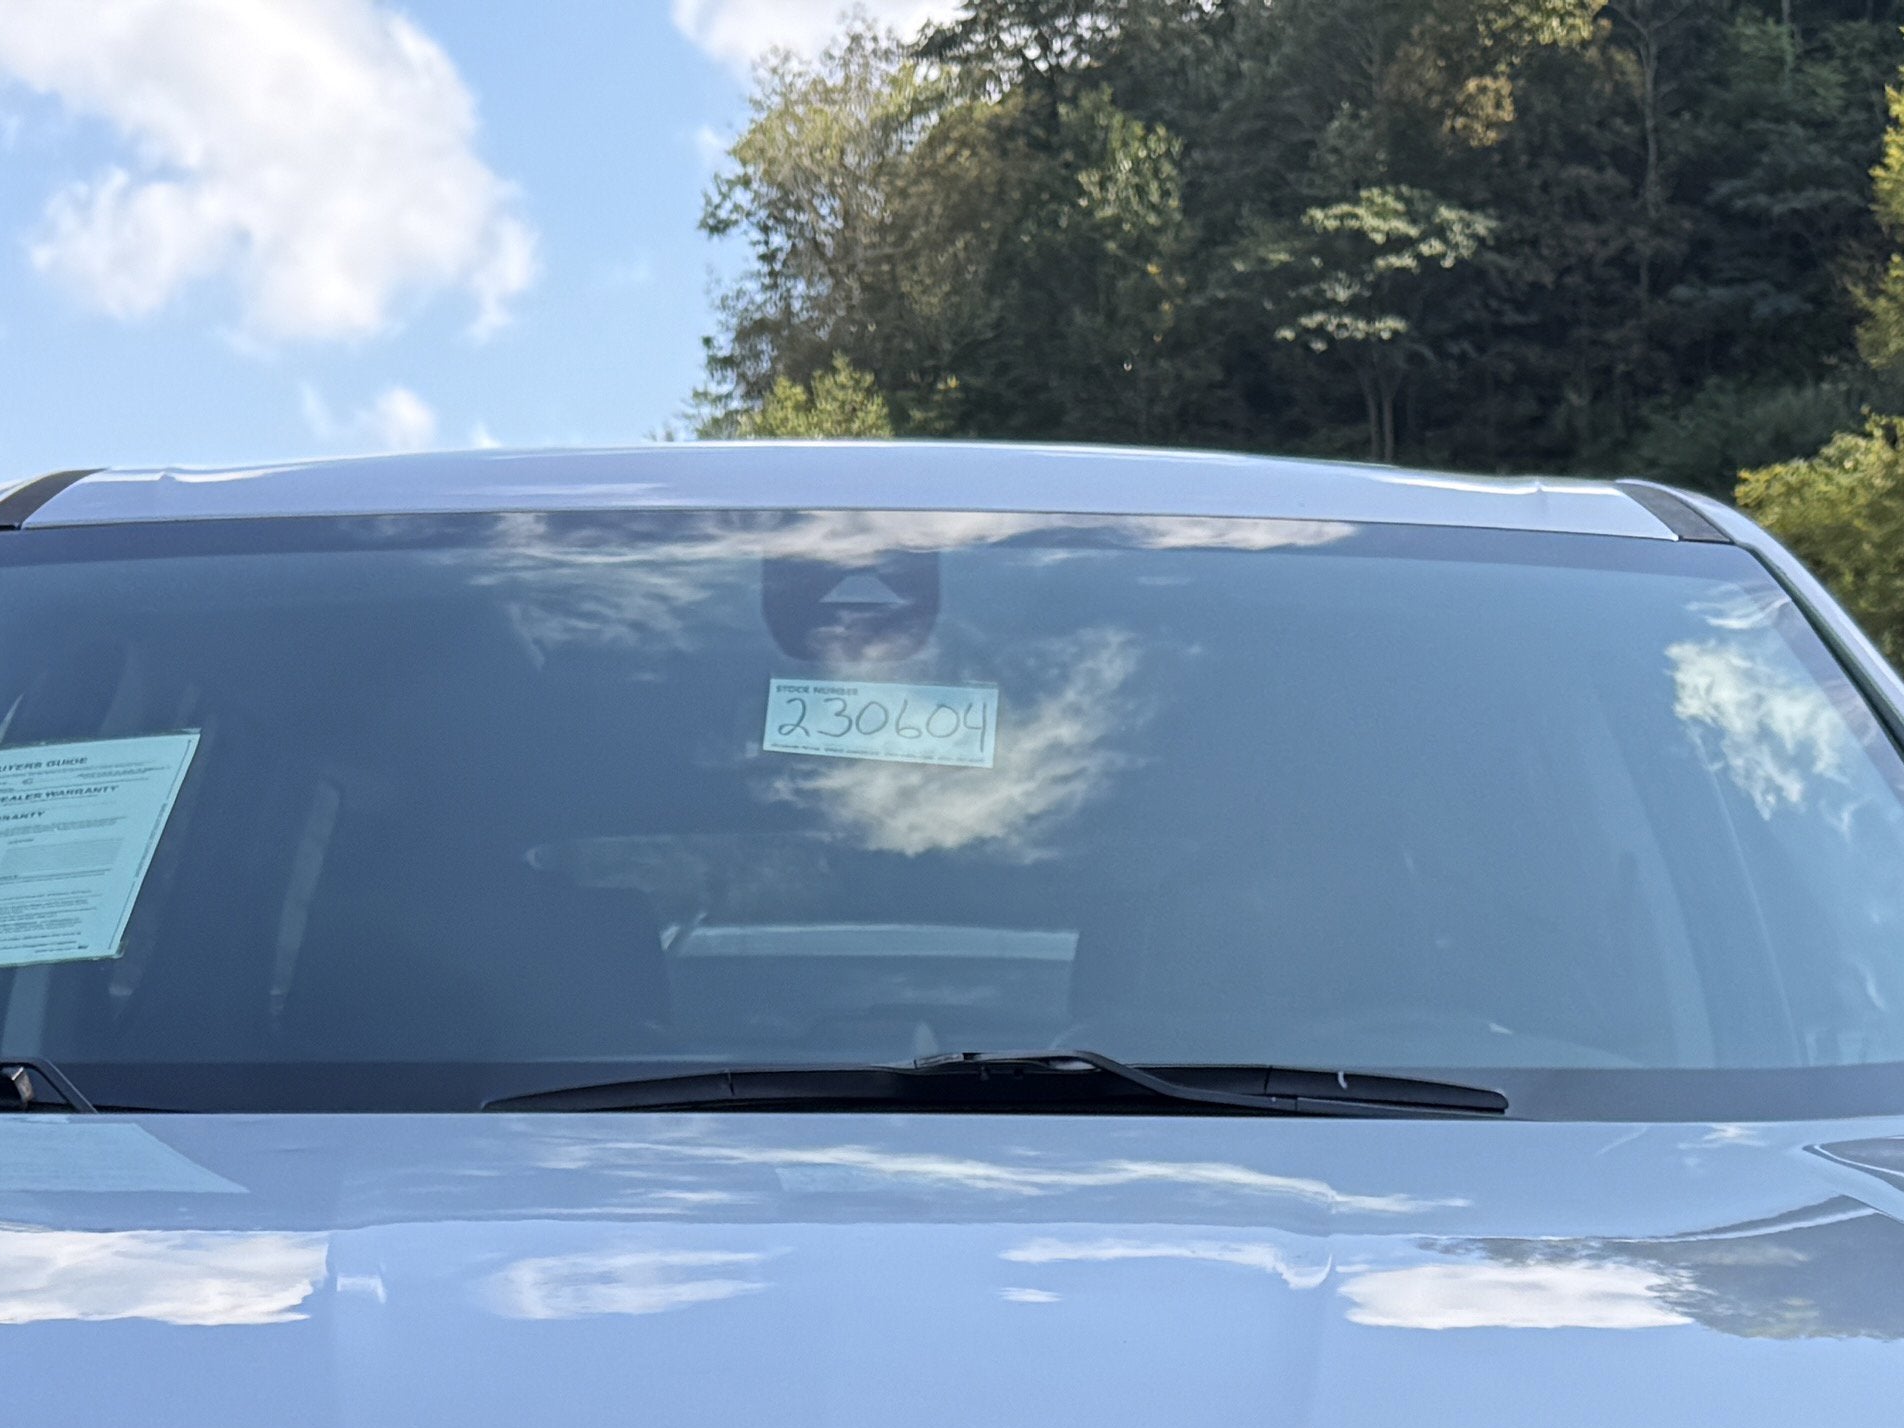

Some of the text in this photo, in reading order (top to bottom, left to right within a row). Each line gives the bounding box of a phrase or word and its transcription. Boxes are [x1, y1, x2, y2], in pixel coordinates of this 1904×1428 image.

[776, 685, 858, 696] STOCK NUMBER
[777, 697, 988, 753] 230604
[46, 756, 88, 768] GUIDE
[45, 785, 119, 799] WARRANTY
